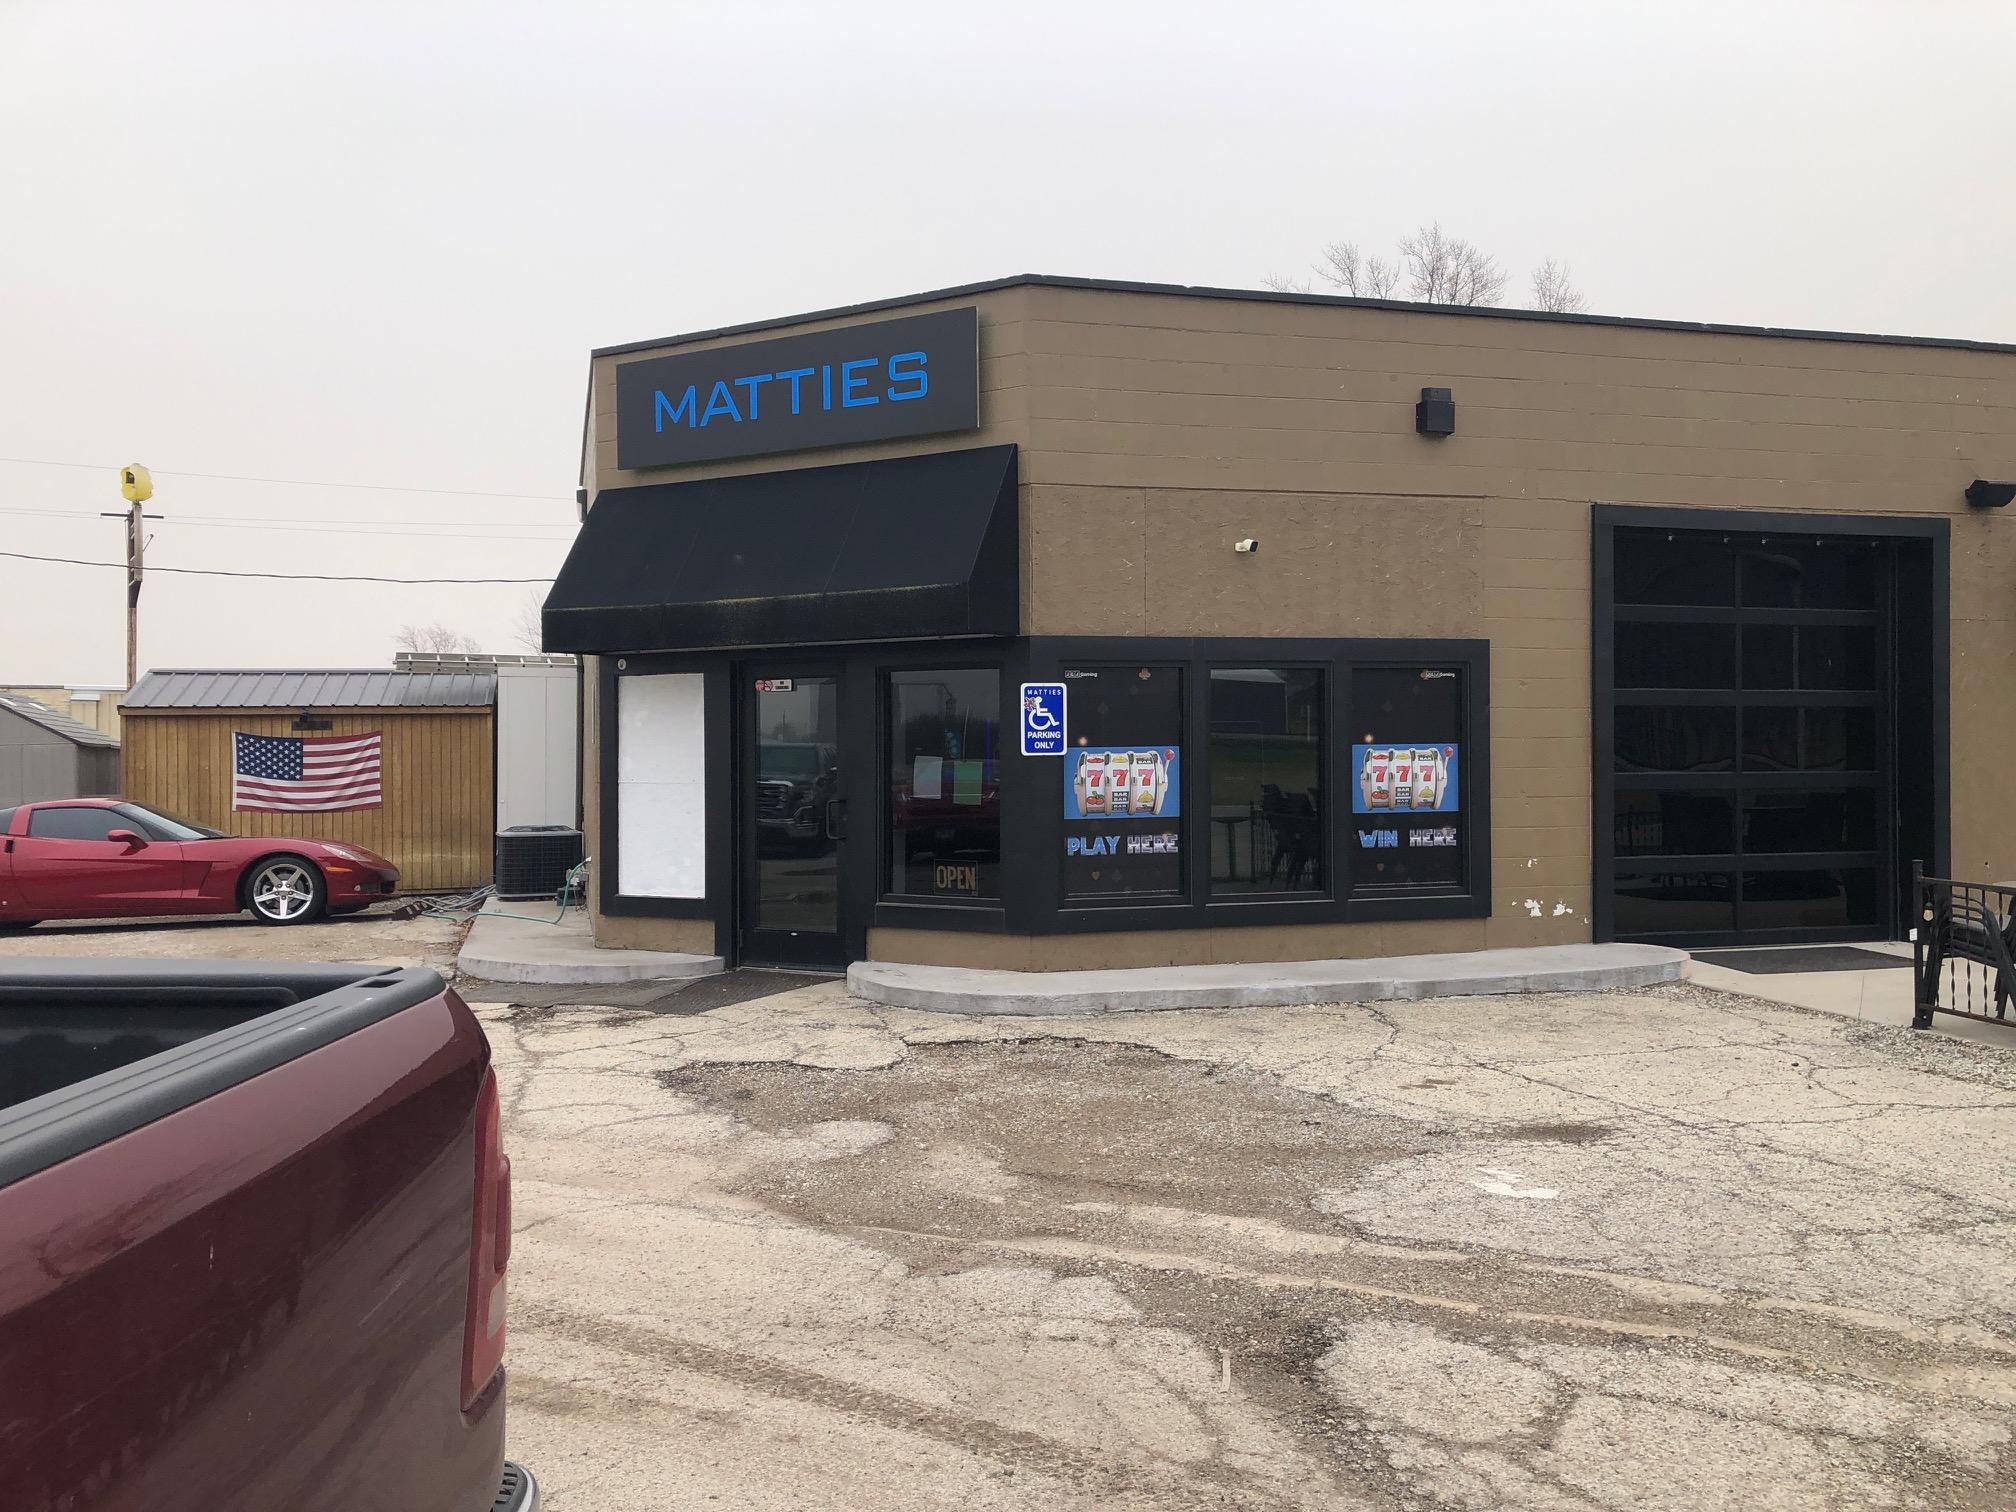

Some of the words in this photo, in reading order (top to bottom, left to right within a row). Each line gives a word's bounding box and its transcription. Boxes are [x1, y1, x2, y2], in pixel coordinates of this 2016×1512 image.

[655, 351, 928, 433] MATTIES
[1027, 731, 1061, 739] PARKING
[1034, 741, 1055, 749] ONLY
[1087, 769, 1104, 787] 7
[1112, 768, 1129, 787] 7
[1137, 768, 1154, 787] 7
[1372, 765, 1388, 783] 7
[1395, 765, 1411, 783] 7
[1419, 765, 1435, 782] 7
[1067, 835, 1121, 856] PLAY
[1126, 834, 1179, 854] HERE
[1358, 830, 1398, 848] WIN
[1409, 828, 1457, 847] HERE
[936, 865, 976, 890] OPEN
